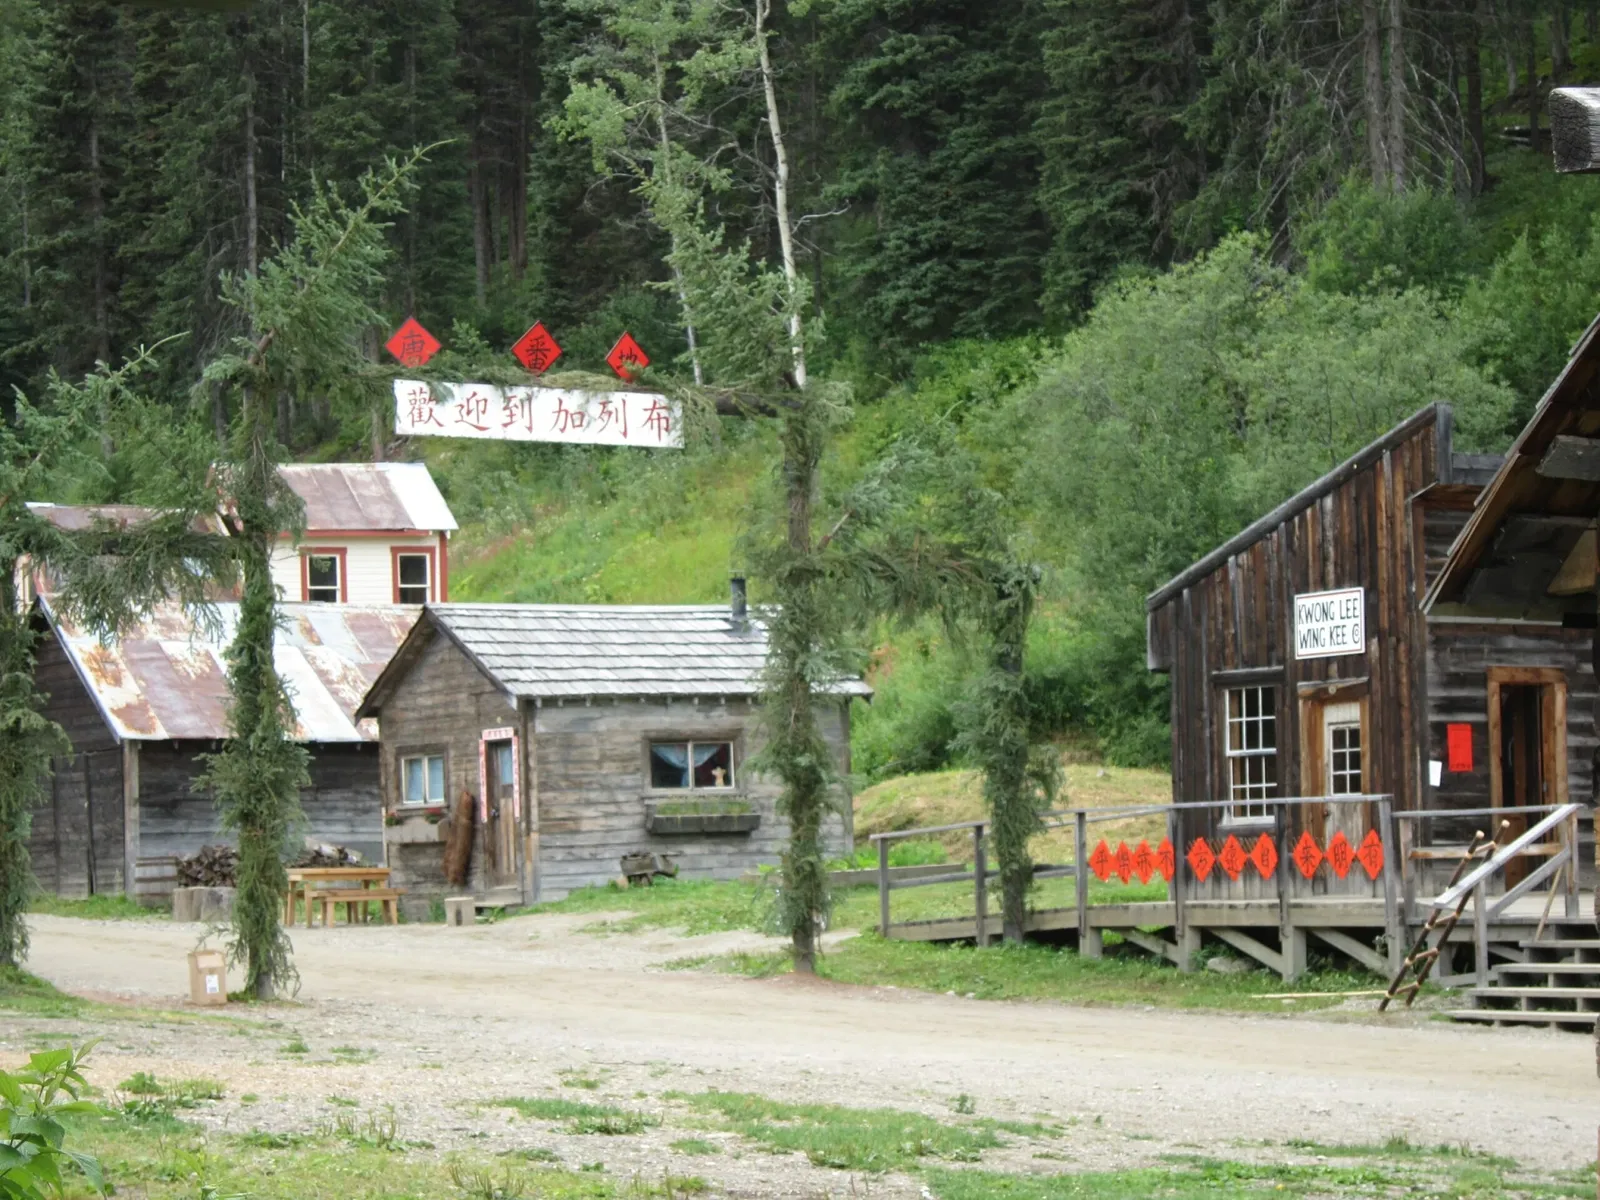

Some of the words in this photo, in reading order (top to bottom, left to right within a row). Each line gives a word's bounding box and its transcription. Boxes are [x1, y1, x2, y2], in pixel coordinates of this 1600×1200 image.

[525, 335, 551, 372] 番
[407, 386, 672, 442] 歡迎到加列布
[1298, 601, 1335, 625] KWONG
[1339, 598, 1359, 620] LEE
[1299, 627, 1325, 649] WING
[1330, 625, 1347, 646] KEE
